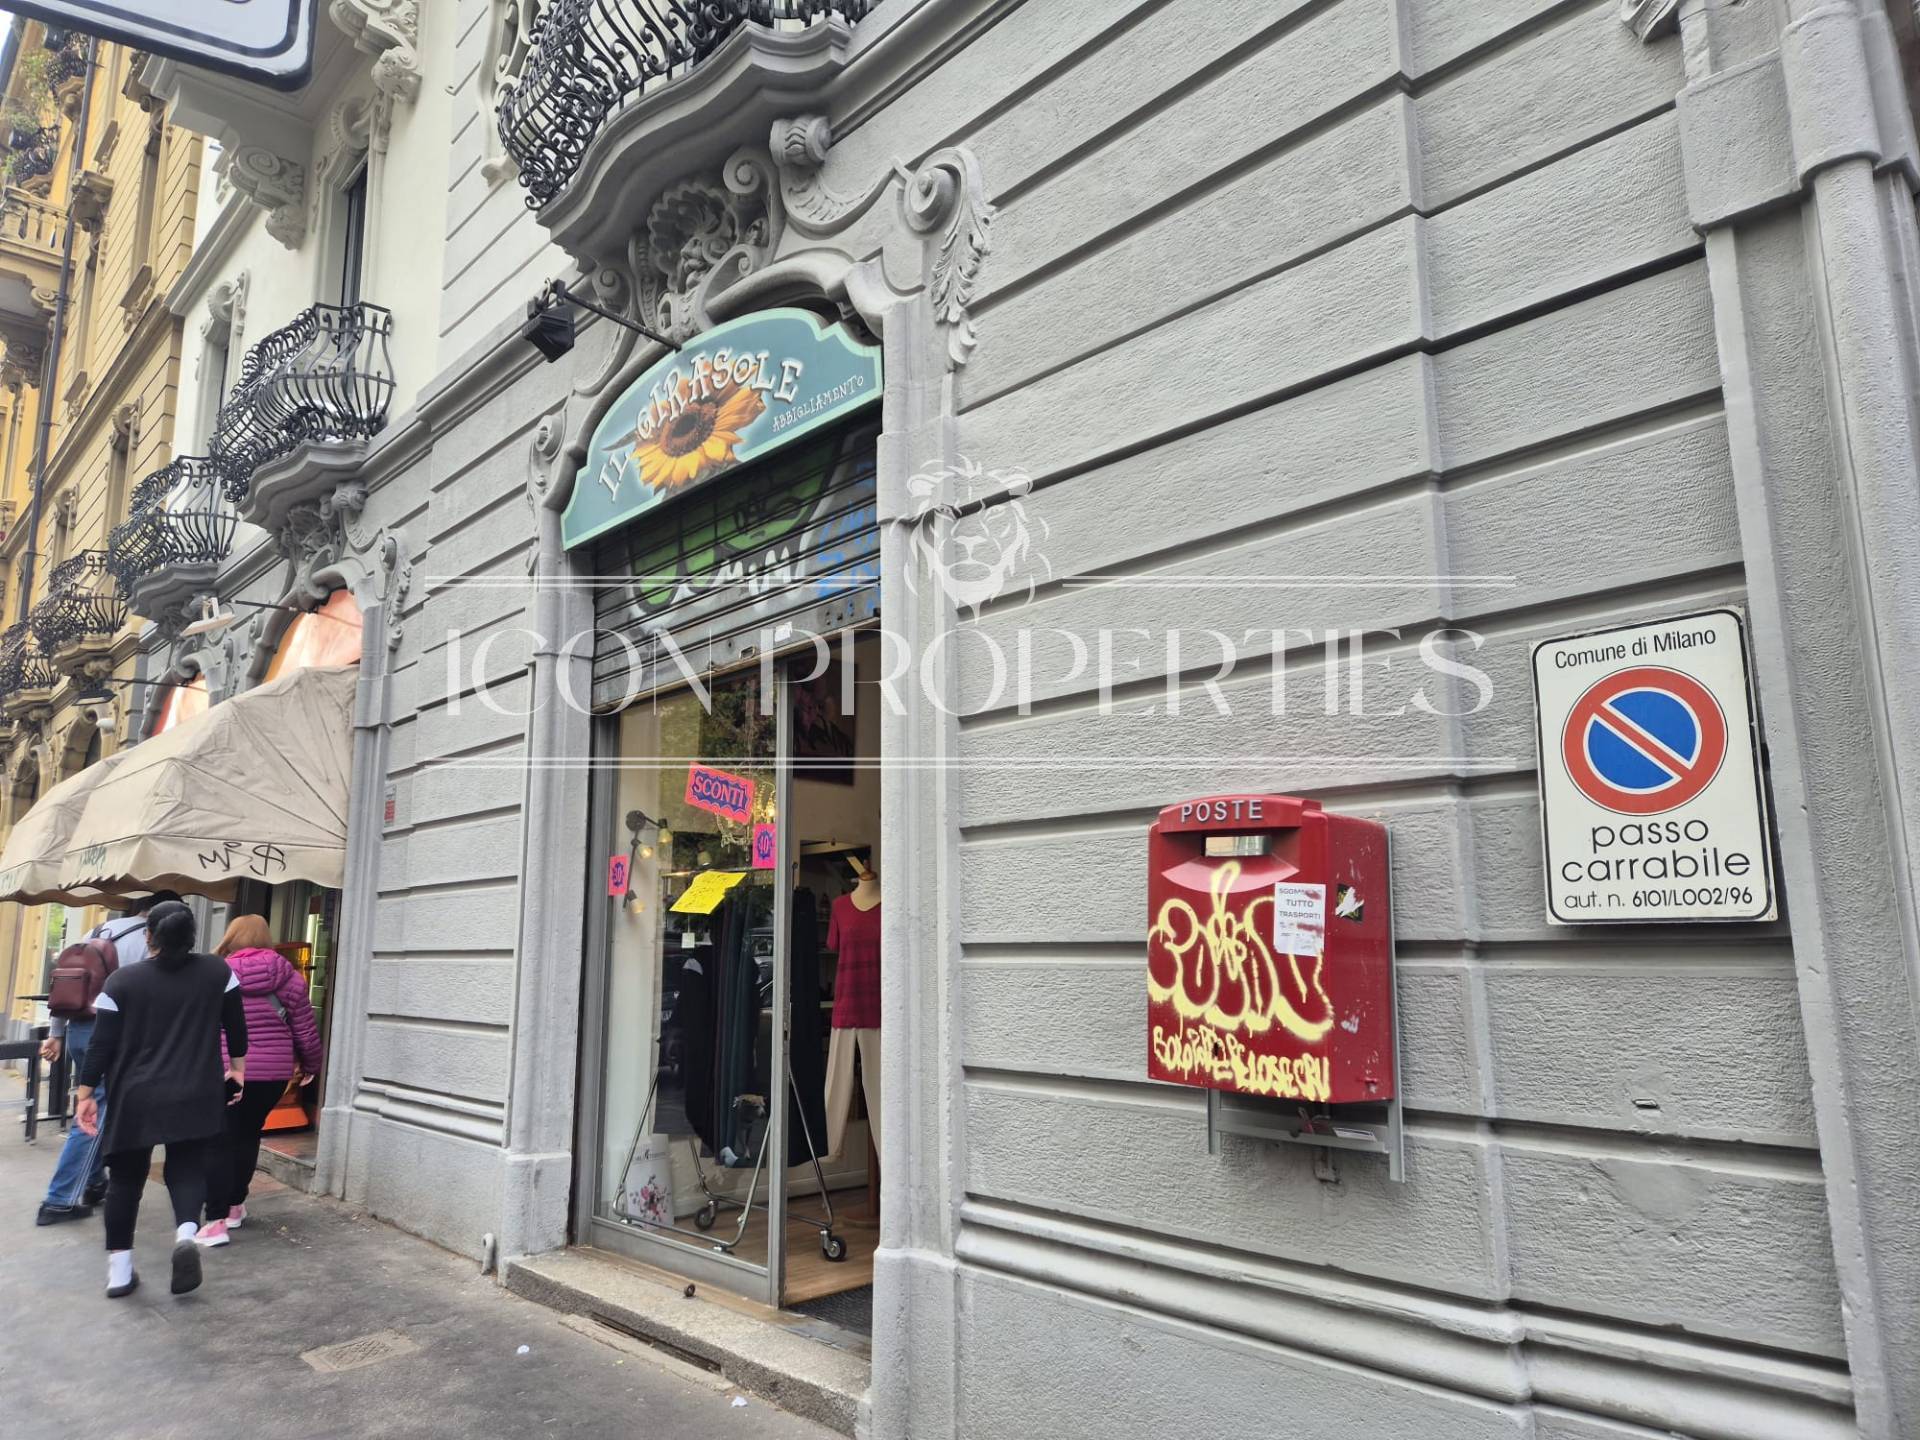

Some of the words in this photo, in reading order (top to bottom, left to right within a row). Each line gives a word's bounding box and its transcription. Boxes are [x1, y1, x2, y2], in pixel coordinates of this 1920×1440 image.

[772, 375, 864, 433] ABBIGLIAMENTO
[598, 454, 631, 502] IL
[637, 347, 803, 441] GIRASOLE
[1555, 642, 1626, 669] Comune
[1632, 637, 1648, 657] di
[1654, 629, 1717, 653] Milano
[693, 775, 745, 809] SCONTI
[1180, 800, 1263, 823] POSTE
[1592, 819, 1709, 854] passo
[1562, 847, 1751, 882] carrabile
[1279, 910, 1321, 920] TRASPORTI
[1286, 898, 1315, 908] TUTTO
[1564, 890, 1602, 909] aut.
[1607, 892, 1626, 908] n.
